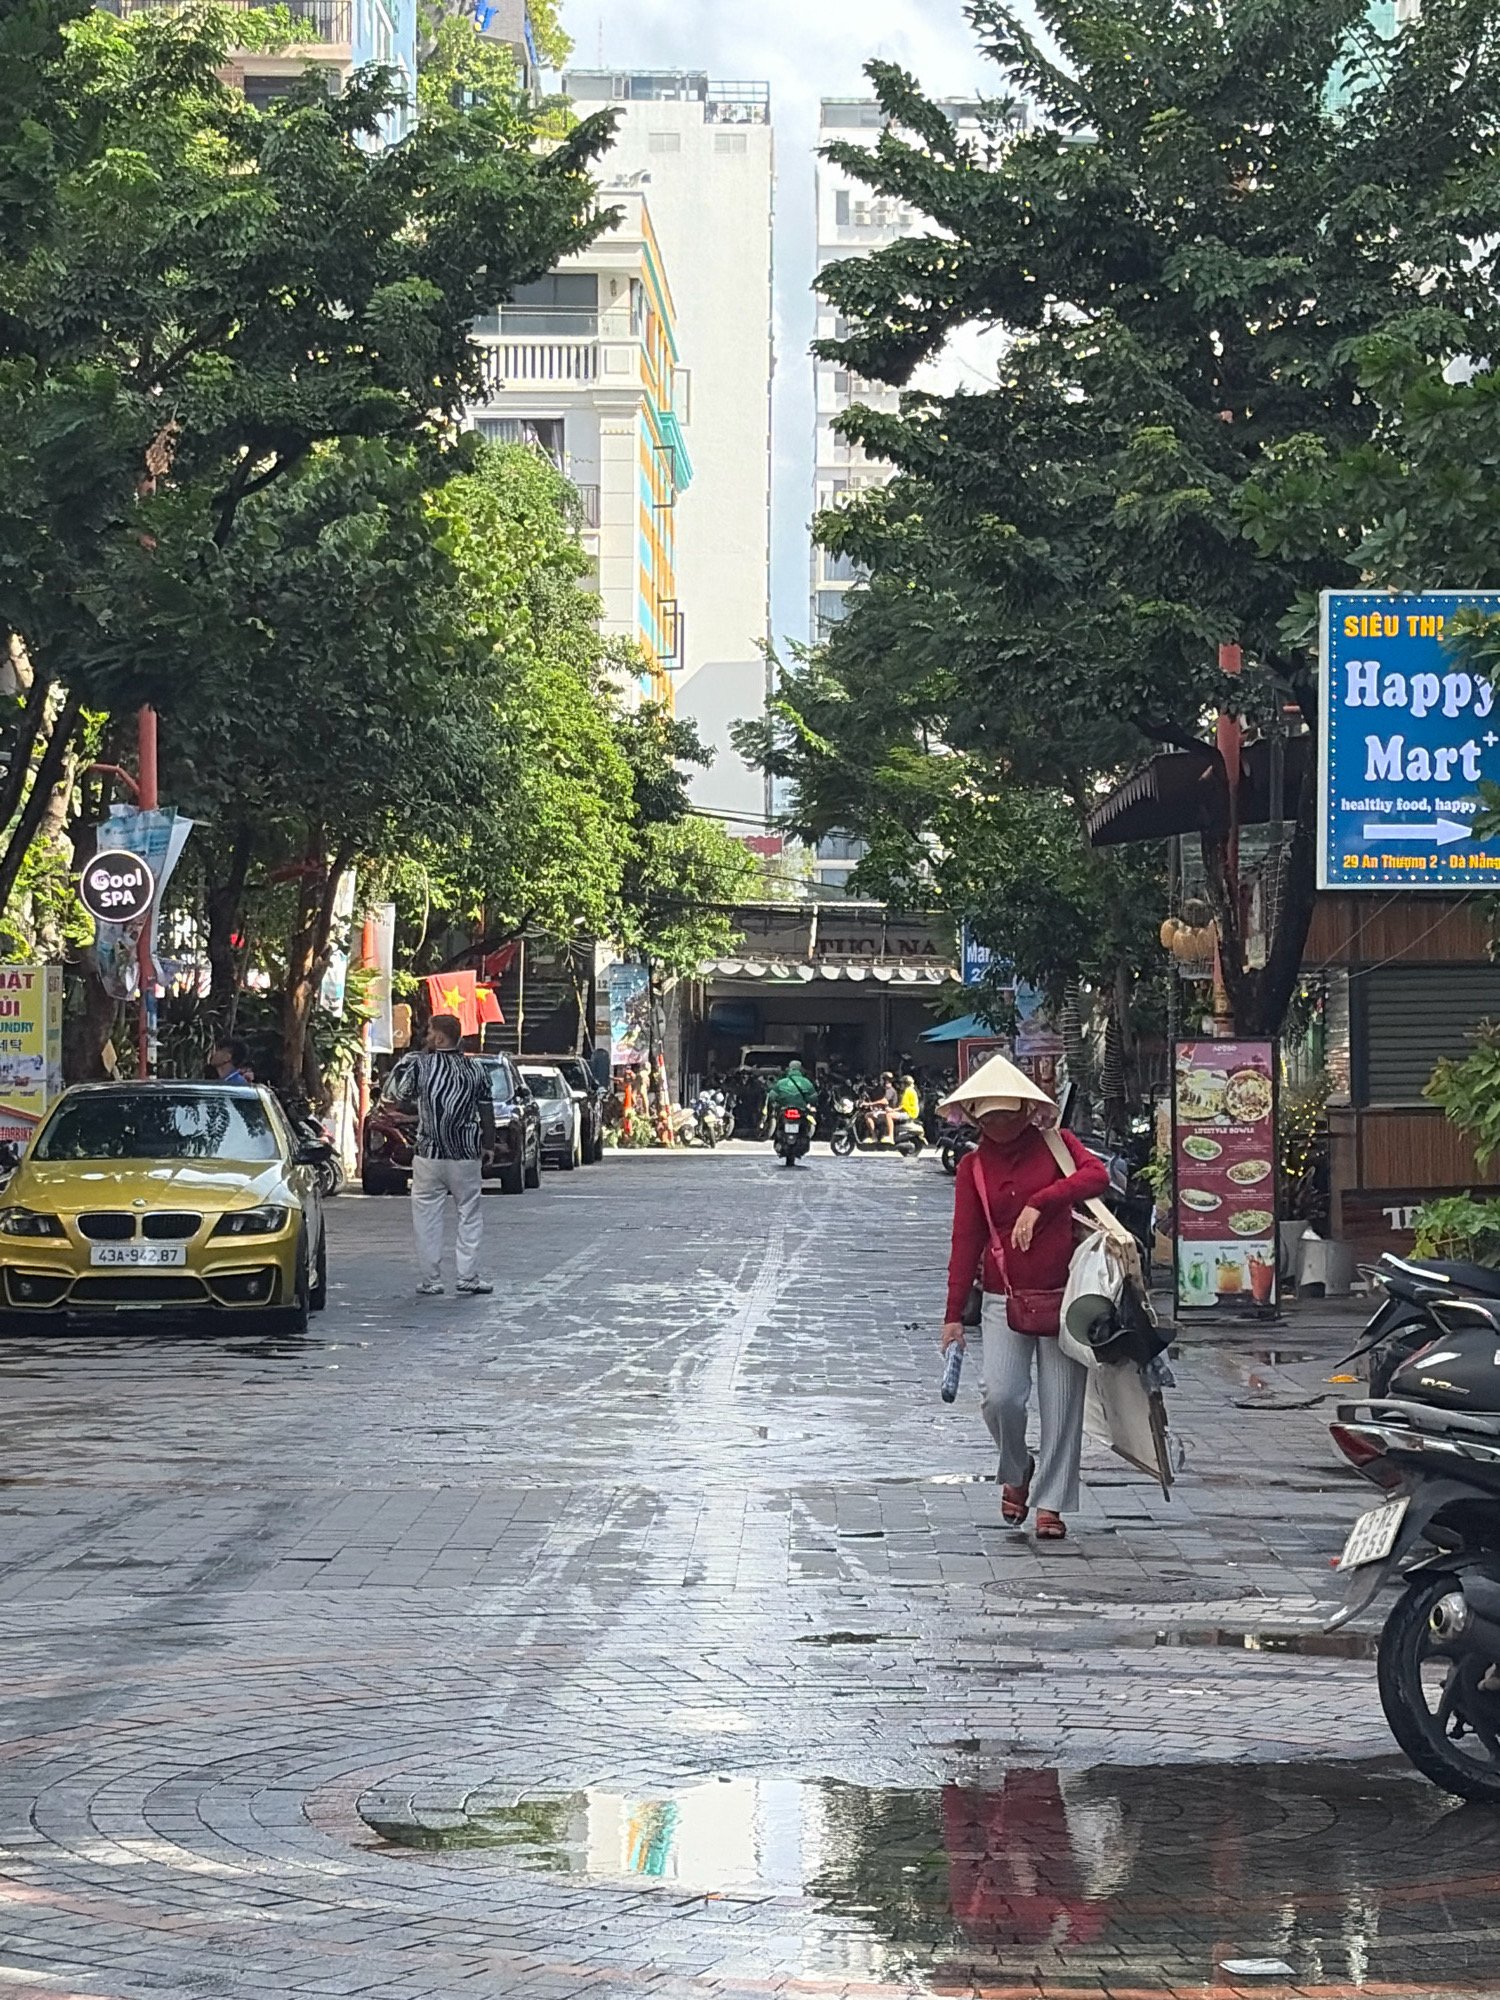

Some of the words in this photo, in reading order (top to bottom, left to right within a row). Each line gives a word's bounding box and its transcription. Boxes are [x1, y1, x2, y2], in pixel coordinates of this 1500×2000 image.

[1344, 611, 1399, 637] SIÊU
[1407, 615, 1444, 641] THỊ
[1344, 661, 1495, 718] Happy
[1341, 797, 1393, 813] healthy
[1396, 797, 1431, 813] food,
[1435, 797, 1477, 813] happy
[1343, 855, 1359, 868] 29
[1362, 855, 1378, 868] An
[1430, 855, 1438, 868] 2
[100, 890, 136, 907] SPA
